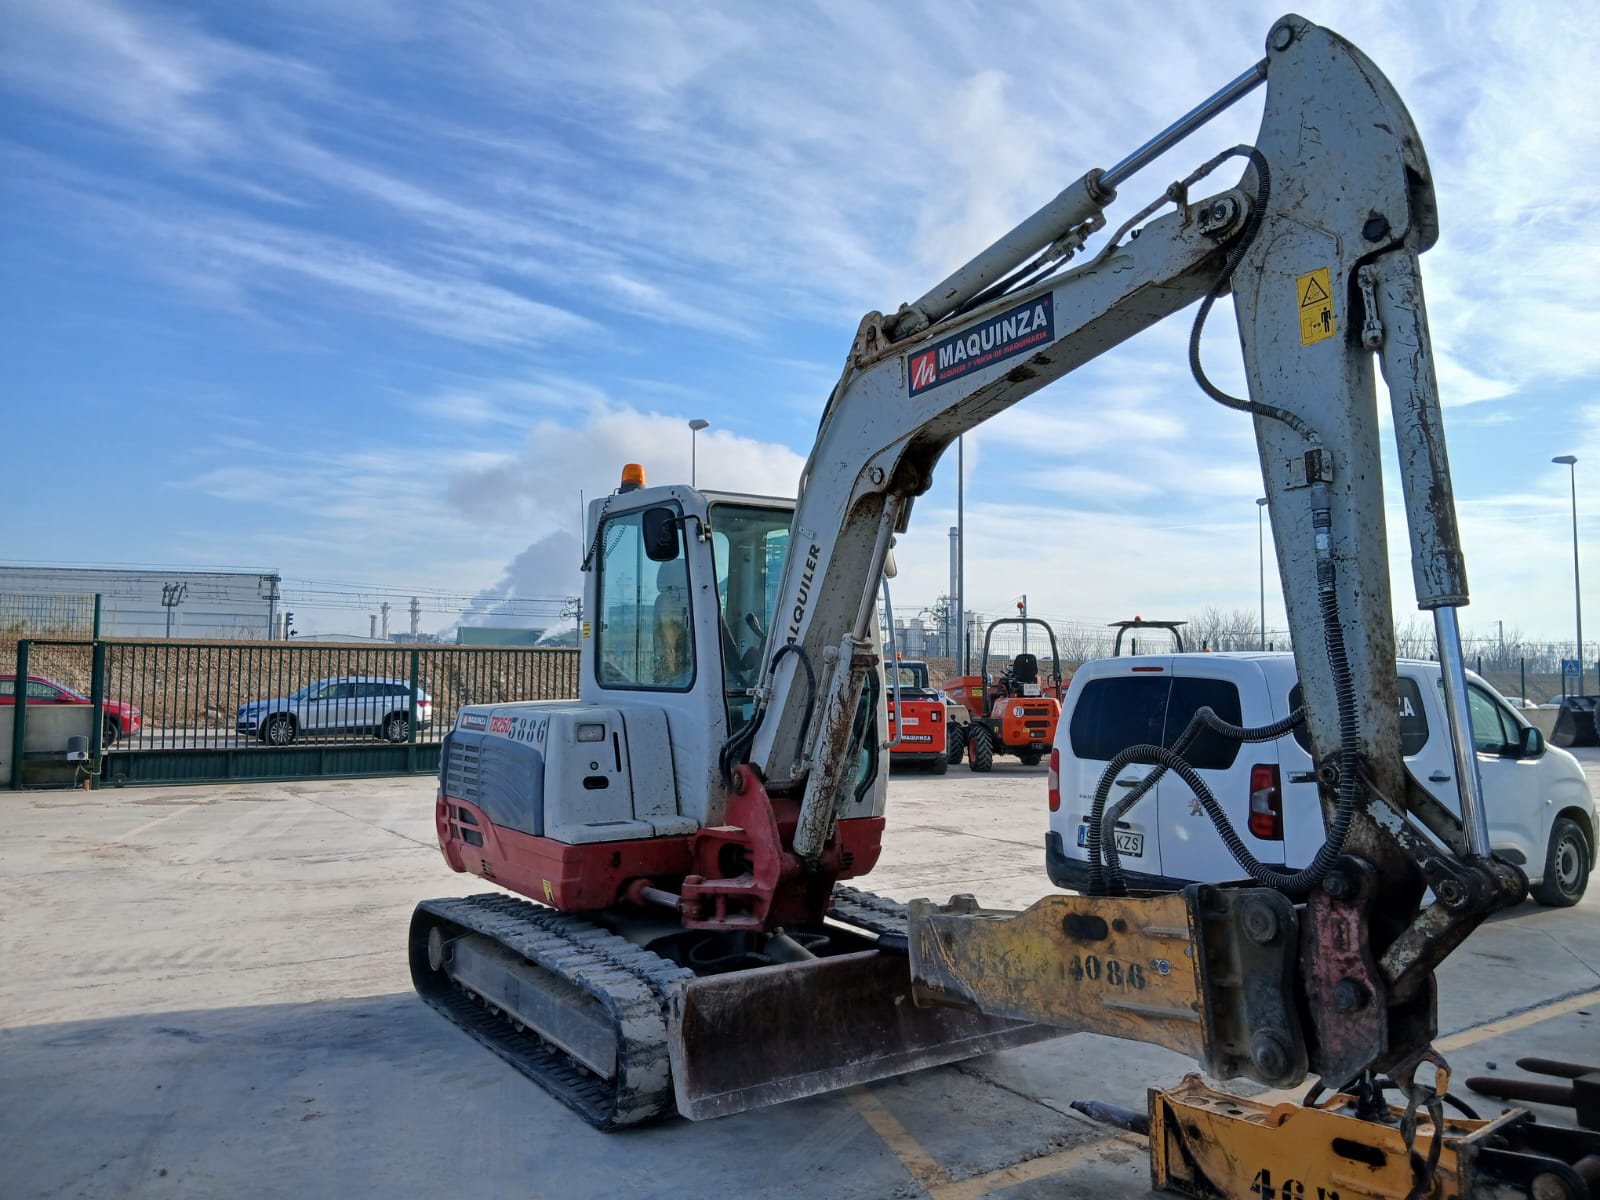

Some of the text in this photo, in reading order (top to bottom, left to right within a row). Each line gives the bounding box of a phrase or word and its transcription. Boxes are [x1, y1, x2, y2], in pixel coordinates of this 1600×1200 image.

[938, 305, 1047, 369] MAQUINZA
[973, 354, 992, 366] VENTA
[994, 350, 1003, 358] DE
[1003, 331, 1048, 353] MAQUINARIA
[786, 543, 821, 645] ALQUILER
[508, 717, 547, 743] 5886
[1116, 834, 1139, 851] KZS
